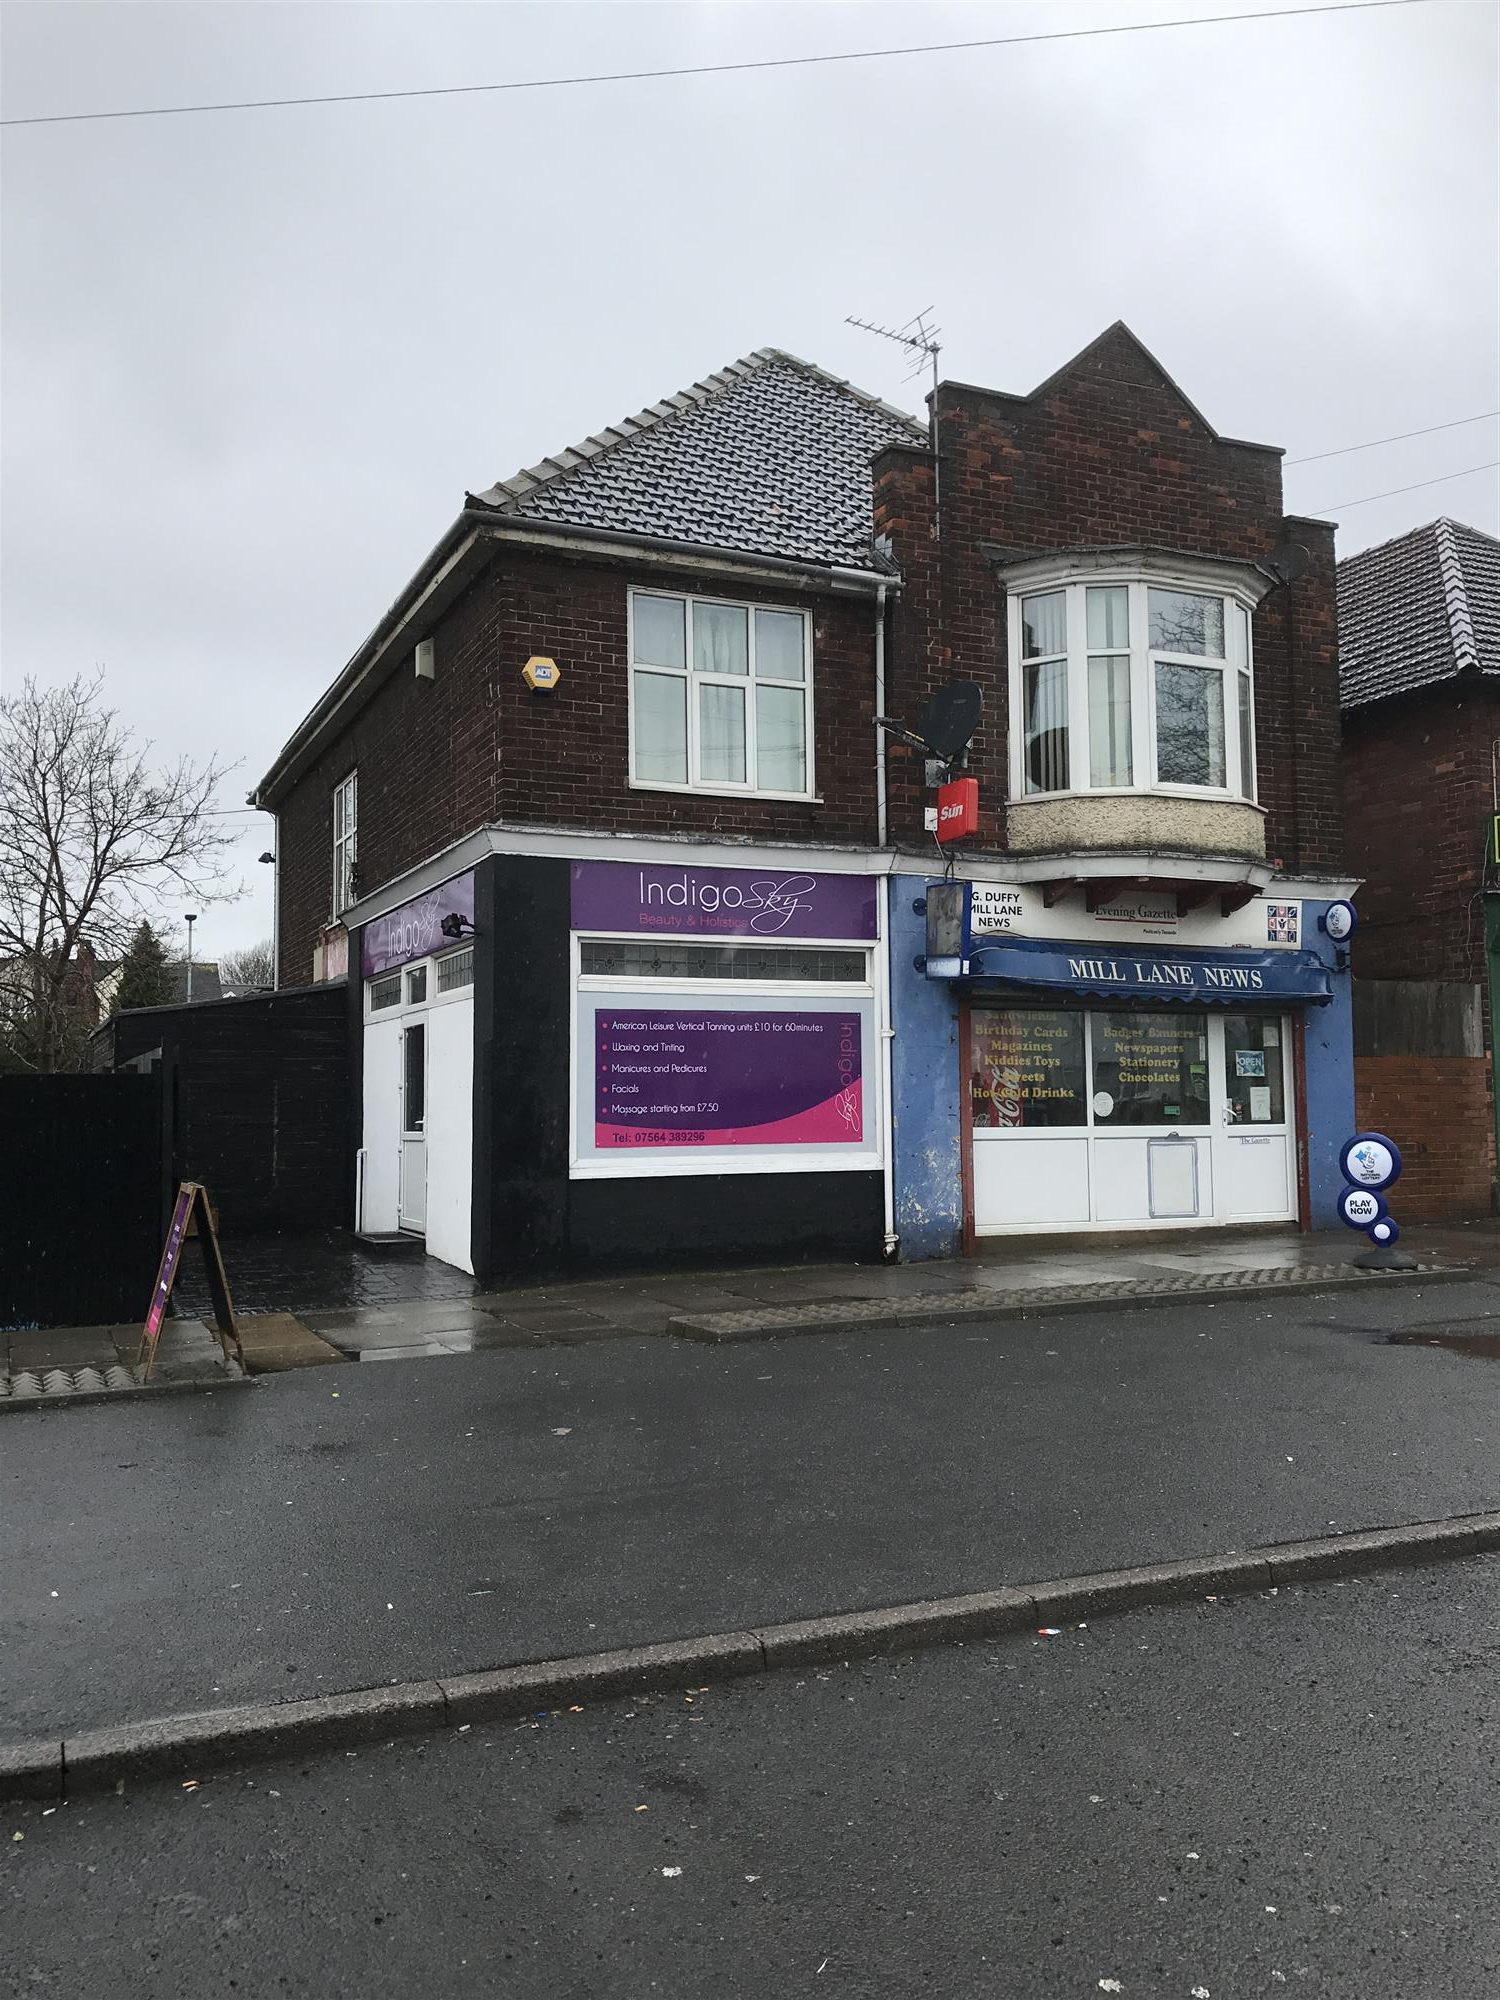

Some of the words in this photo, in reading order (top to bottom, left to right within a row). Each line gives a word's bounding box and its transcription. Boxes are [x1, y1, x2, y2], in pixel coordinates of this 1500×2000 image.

[536, 668, 551, 677] ADT
[640, 871, 743, 912] Indigo
[971, 891, 982, 901] G.
[985, 892, 1020, 903] DUFFY
[994, 905, 1023, 915] LANE
[1095, 904, 1136, 920] Evening
[1138, 904, 1177, 919] Gazette
[639, 913, 682, 927] Beauty
[686, 915, 696, 926] &
[978, 917, 1011, 928] NEWS
[1068, 959, 1126, 981] MILL
[1134, 963, 1195, 985] LANE
[1202, 967, 1264, 989] NEWS
[612, 1021, 647, 1030] American
[649, 1021, 675, 1030] Leisure
[676, 1021, 705, 1030] Vertical
[706, 1022, 736, 1032] Tanning
[737, 1023, 753, 1031] units
[754, 1022, 770, 1031] £10
[772, 1022, 782, 1031] for
[975, 1023, 1030, 1038] Birthday
[1034, 1026, 1068, 1038] Cards
[1103, 1027, 1145, 1040] Badges
[1148, 1027, 1194, 1039] Banners
[612, 1042, 640, 1052] Waxing
[642, 1043, 659, 1052] and
[660, 1042, 685, 1053] Tinting
[991, 1040, 1053, 1053] Magazines
[1115, 1042, 1185, 1055] Newspapers
[984, 1055, 1031, 1066] Kiddies
[1033, 1056, 1061, 1068] Toys
[1119, 1056, 1181, 1069] Stationery
[1239, 1057, 1261, 1066] OPEN
[611, 1063, 651, 1073] Manicures
[653, 1064, 670, 1073] and
[671, 1063, 708, 1073] Pedicures
[1118, 1072, 1181, 1082] Chocolates
[611, 1083, 640, 1093] Facials
[1032, 1087, 1075, 1098] Drinks
[611, 1104, 648, 1114] Massage
[650, 1104, 678, 1114] starting
[680, 1103, 696, 1112] from
[697, 1102, 719, 1112] £7.50
[613, 1133, 631, 1142] Tel:
[635, 1132, 666, 1142] 07564
[669, 1132, 705, 1141] 389296
[1349, 1200, 1372, 1208] PLAY
[1350, 1207, 1373, 1215] NOW
